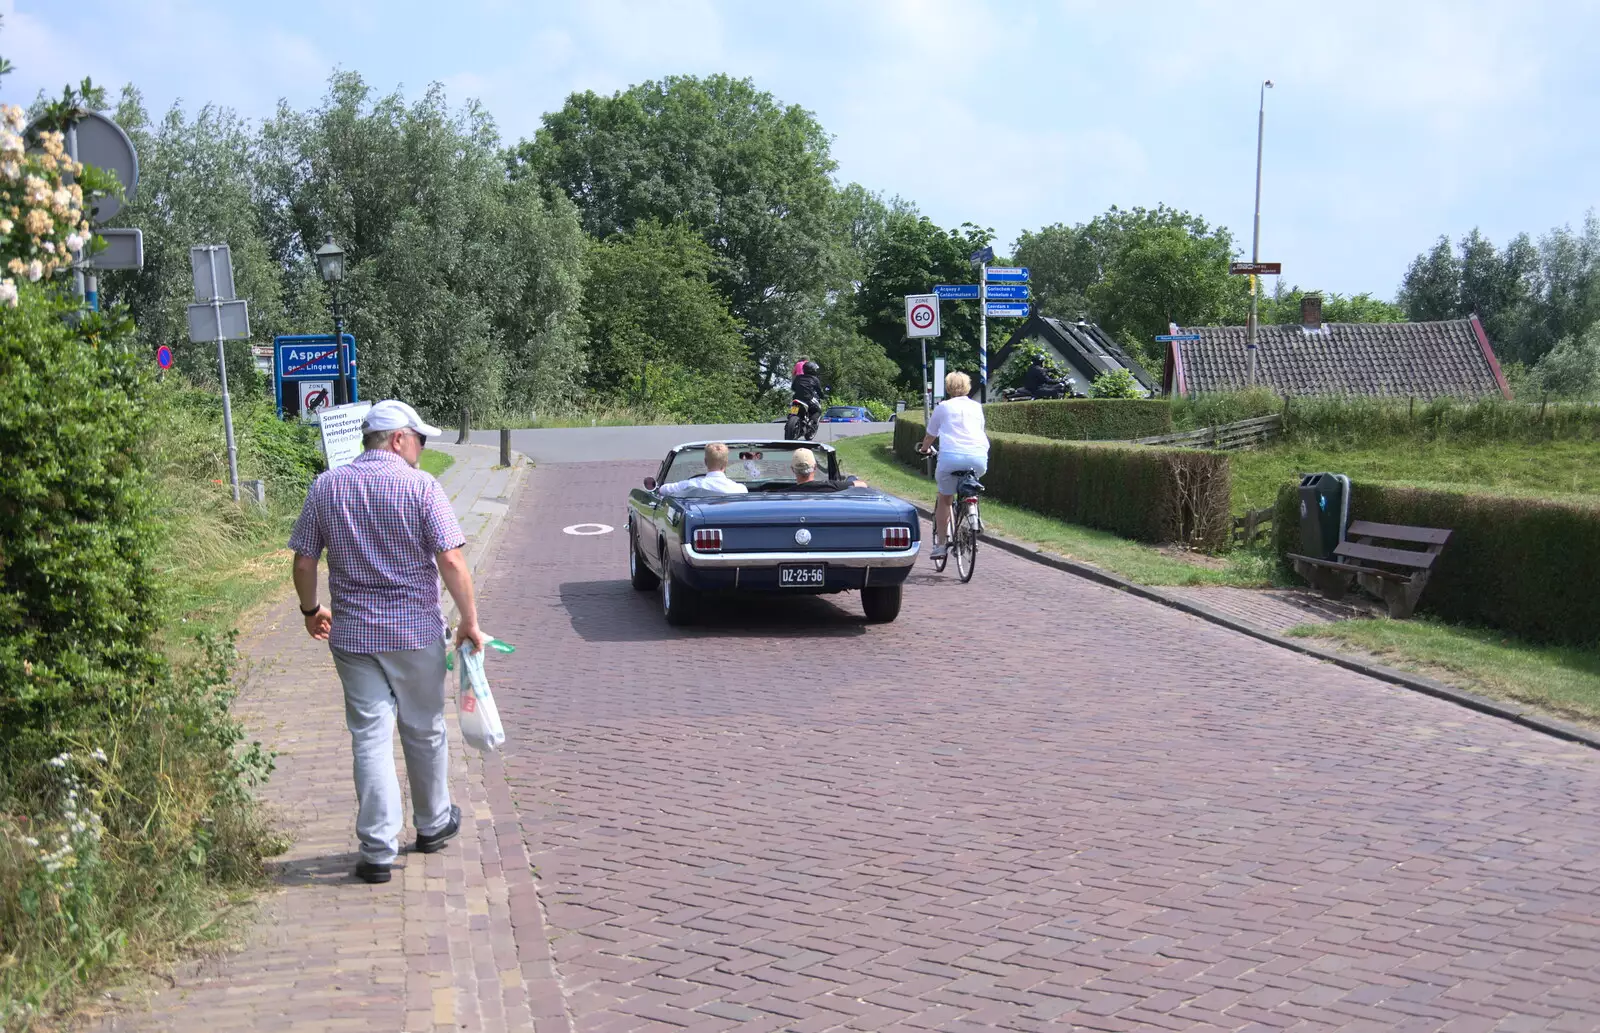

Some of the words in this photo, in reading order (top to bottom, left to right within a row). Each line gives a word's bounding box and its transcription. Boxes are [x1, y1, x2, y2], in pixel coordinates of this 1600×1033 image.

[915, 312, 930, 321] 60
[323, 413, 347, 422] Samen
[325, 418, 360, 429] investeren
[782, 569, 822, 582] DZ-25-56
